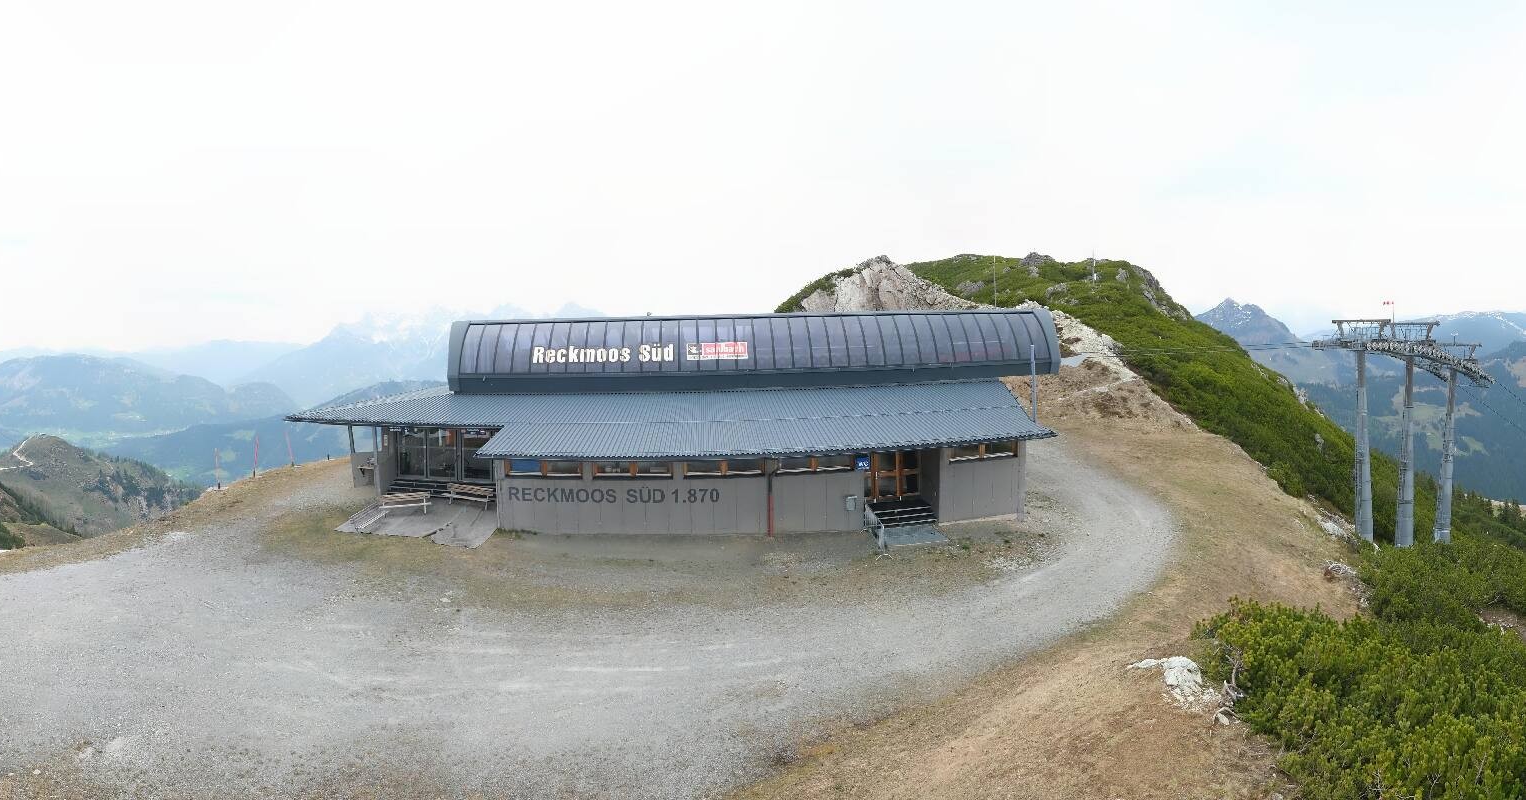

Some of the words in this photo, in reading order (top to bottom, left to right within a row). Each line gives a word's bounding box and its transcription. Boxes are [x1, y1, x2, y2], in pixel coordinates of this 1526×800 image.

[532, 346, 631, 364] Reckmoos
[638, 343, 674, 362] Süd
[508, 486, 617, 503] RECKMOOS
[626, 486, 665, 504] SÜD
[672, 488, 720, 503] 1.870
